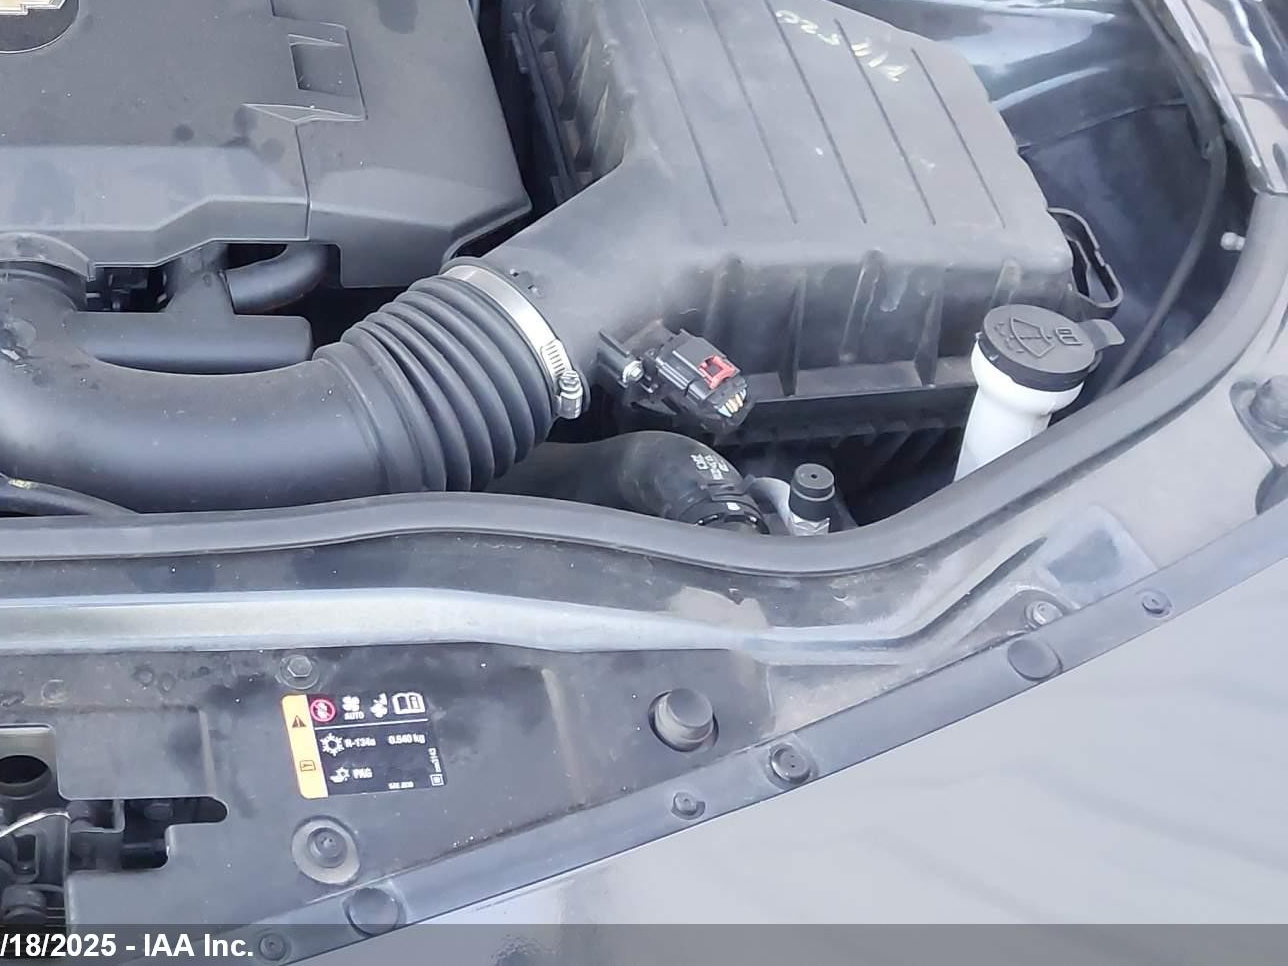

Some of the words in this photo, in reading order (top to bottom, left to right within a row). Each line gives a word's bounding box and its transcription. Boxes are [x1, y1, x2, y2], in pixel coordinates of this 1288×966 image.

[344, 711, 364, 720] AUTO
[344, 737, 376, 747] R-134a
[413, 733, 425, 744] kg
[352, 766, 372, 778] PAG
